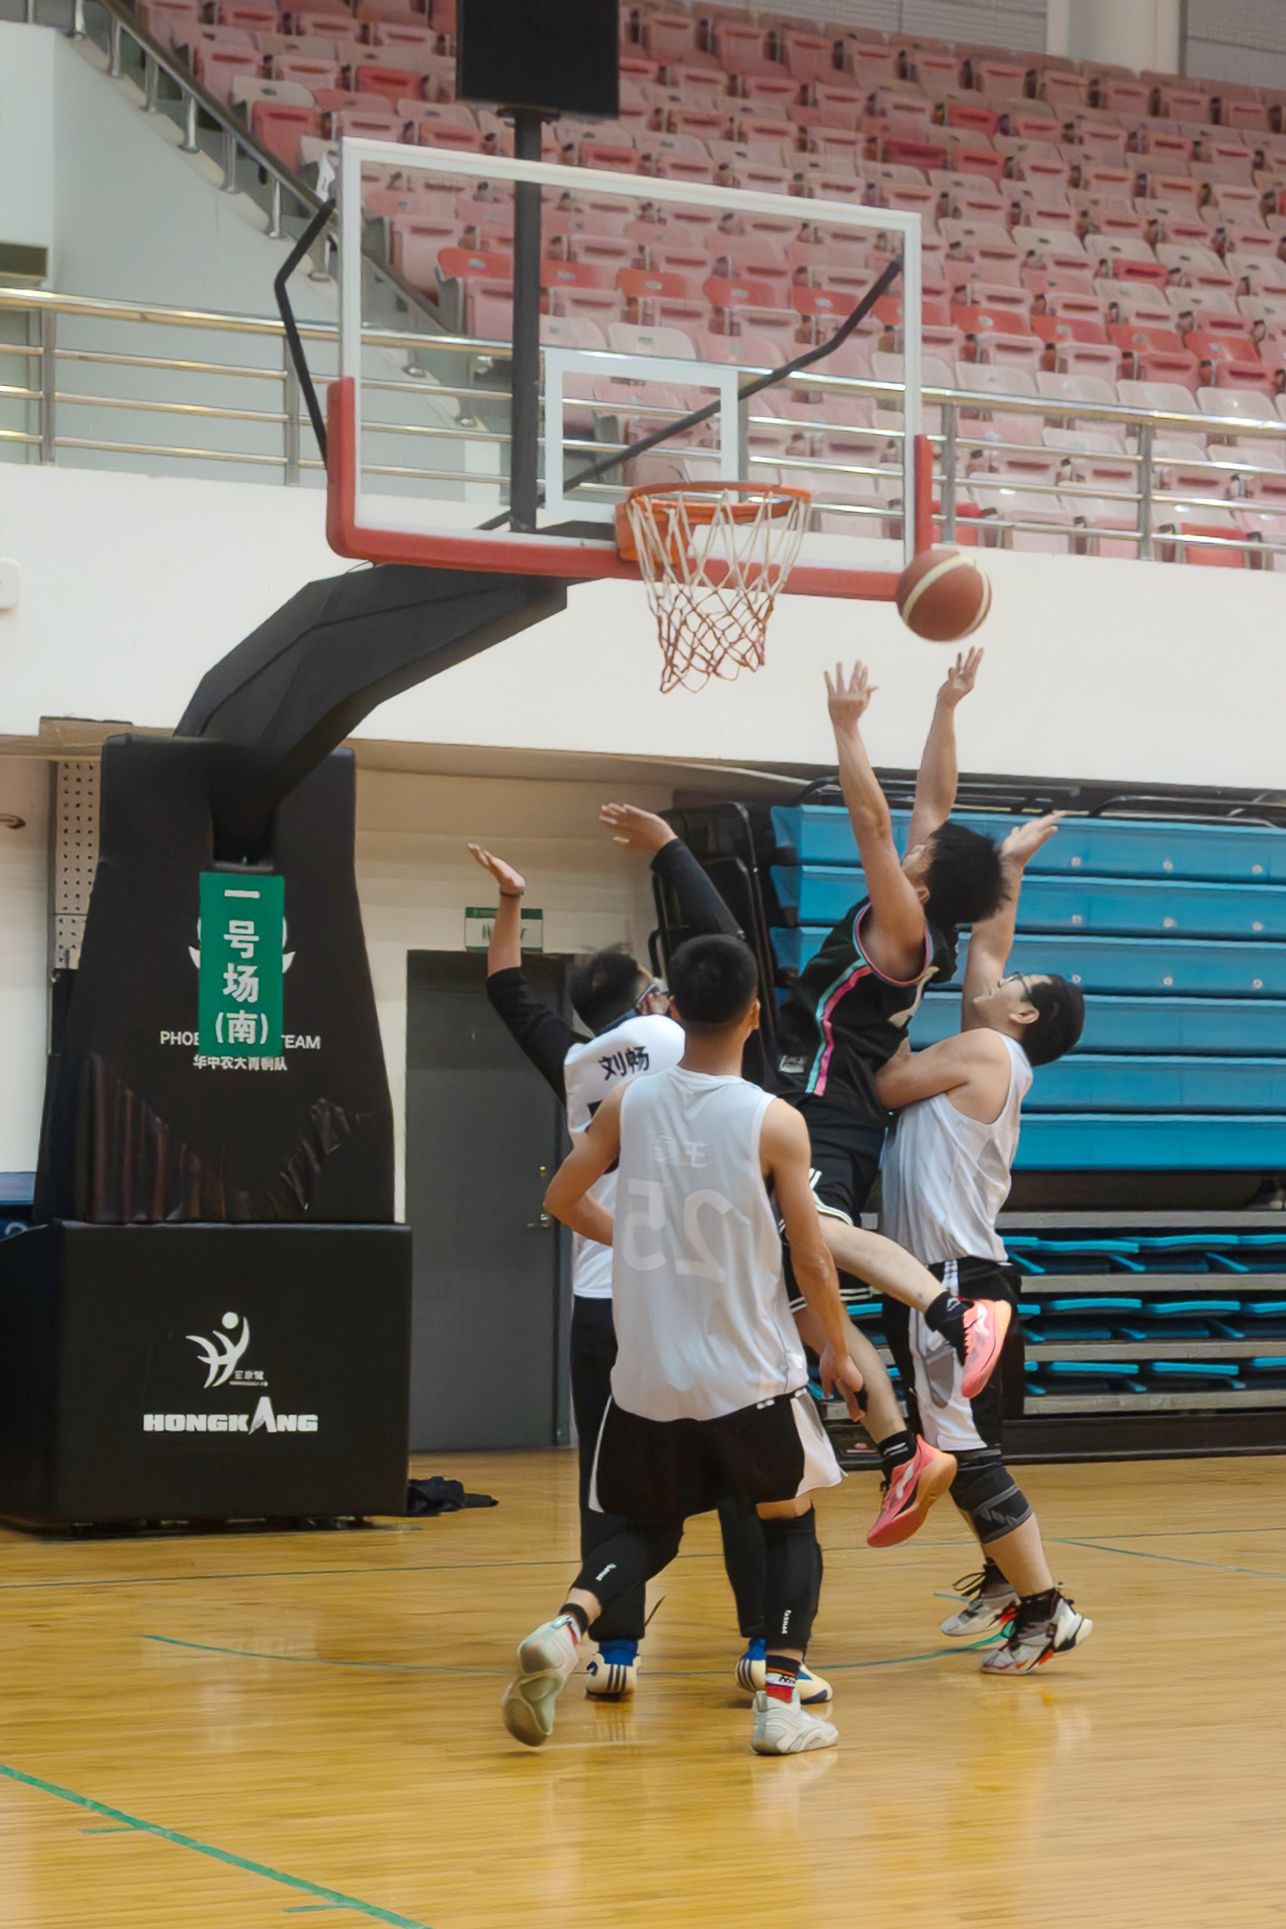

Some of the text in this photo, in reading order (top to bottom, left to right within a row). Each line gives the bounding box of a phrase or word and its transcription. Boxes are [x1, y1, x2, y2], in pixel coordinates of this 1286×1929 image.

[214, 889, 269, 1045] 一号场(南)
[280, 1034, 321, 1050] EAM
[598, 1046, 650, 1081] 刘畅
[143, 1396, 319, 1435] HONGKANG
